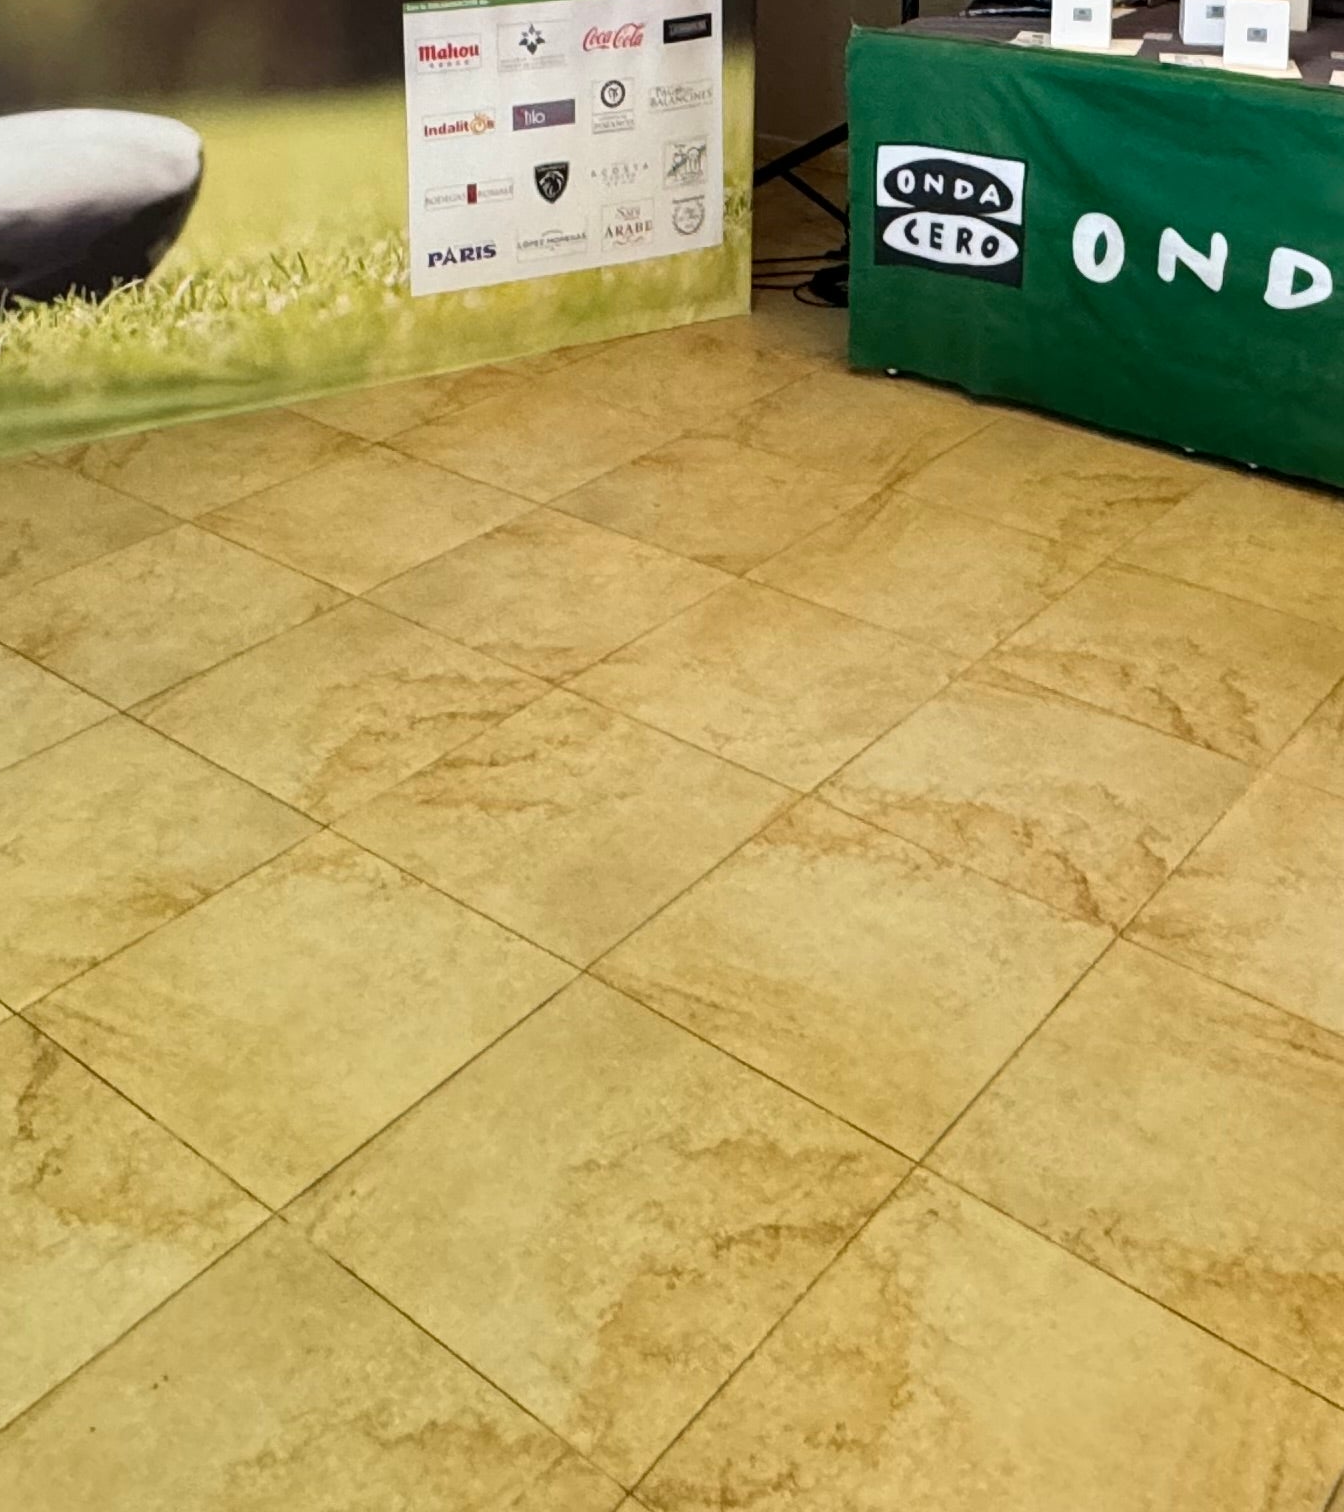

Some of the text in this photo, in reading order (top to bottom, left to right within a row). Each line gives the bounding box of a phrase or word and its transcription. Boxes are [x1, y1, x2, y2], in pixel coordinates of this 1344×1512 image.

[418, 42, 480, 62] Mahou
[896, 169, 1001, 207] ONDA
[903, 217, 1000, 259] CERO
[427, 244, 497, 269] PARIS
